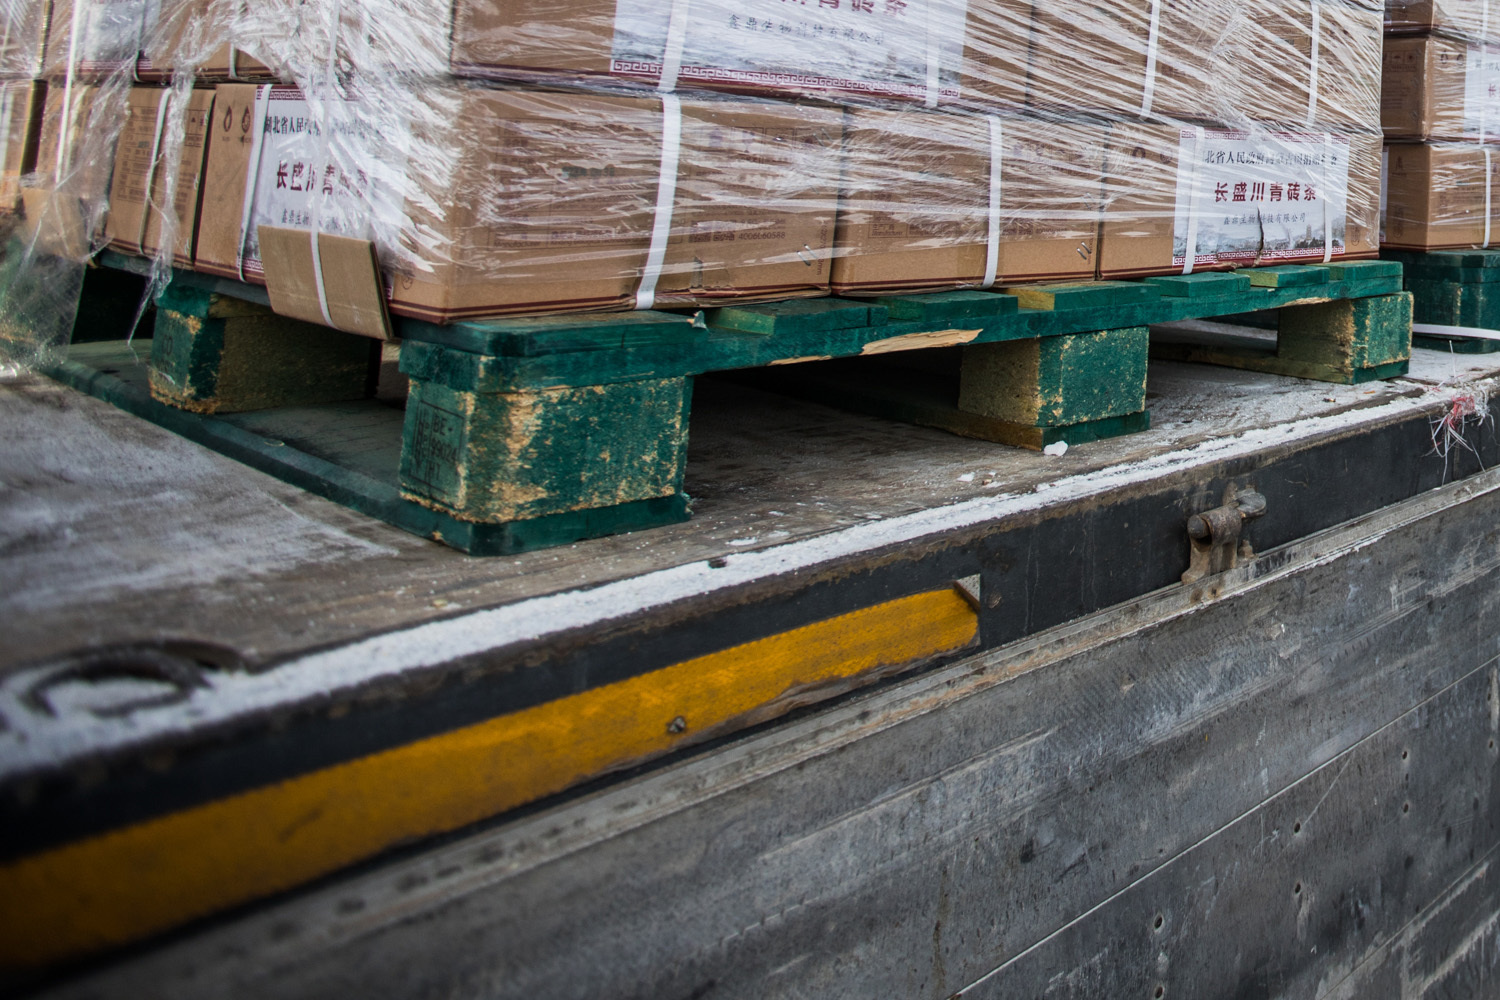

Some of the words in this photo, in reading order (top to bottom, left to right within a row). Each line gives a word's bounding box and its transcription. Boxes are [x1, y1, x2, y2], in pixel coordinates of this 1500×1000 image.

[1214, 181, 1318, 203] 长盛川青砖茶
